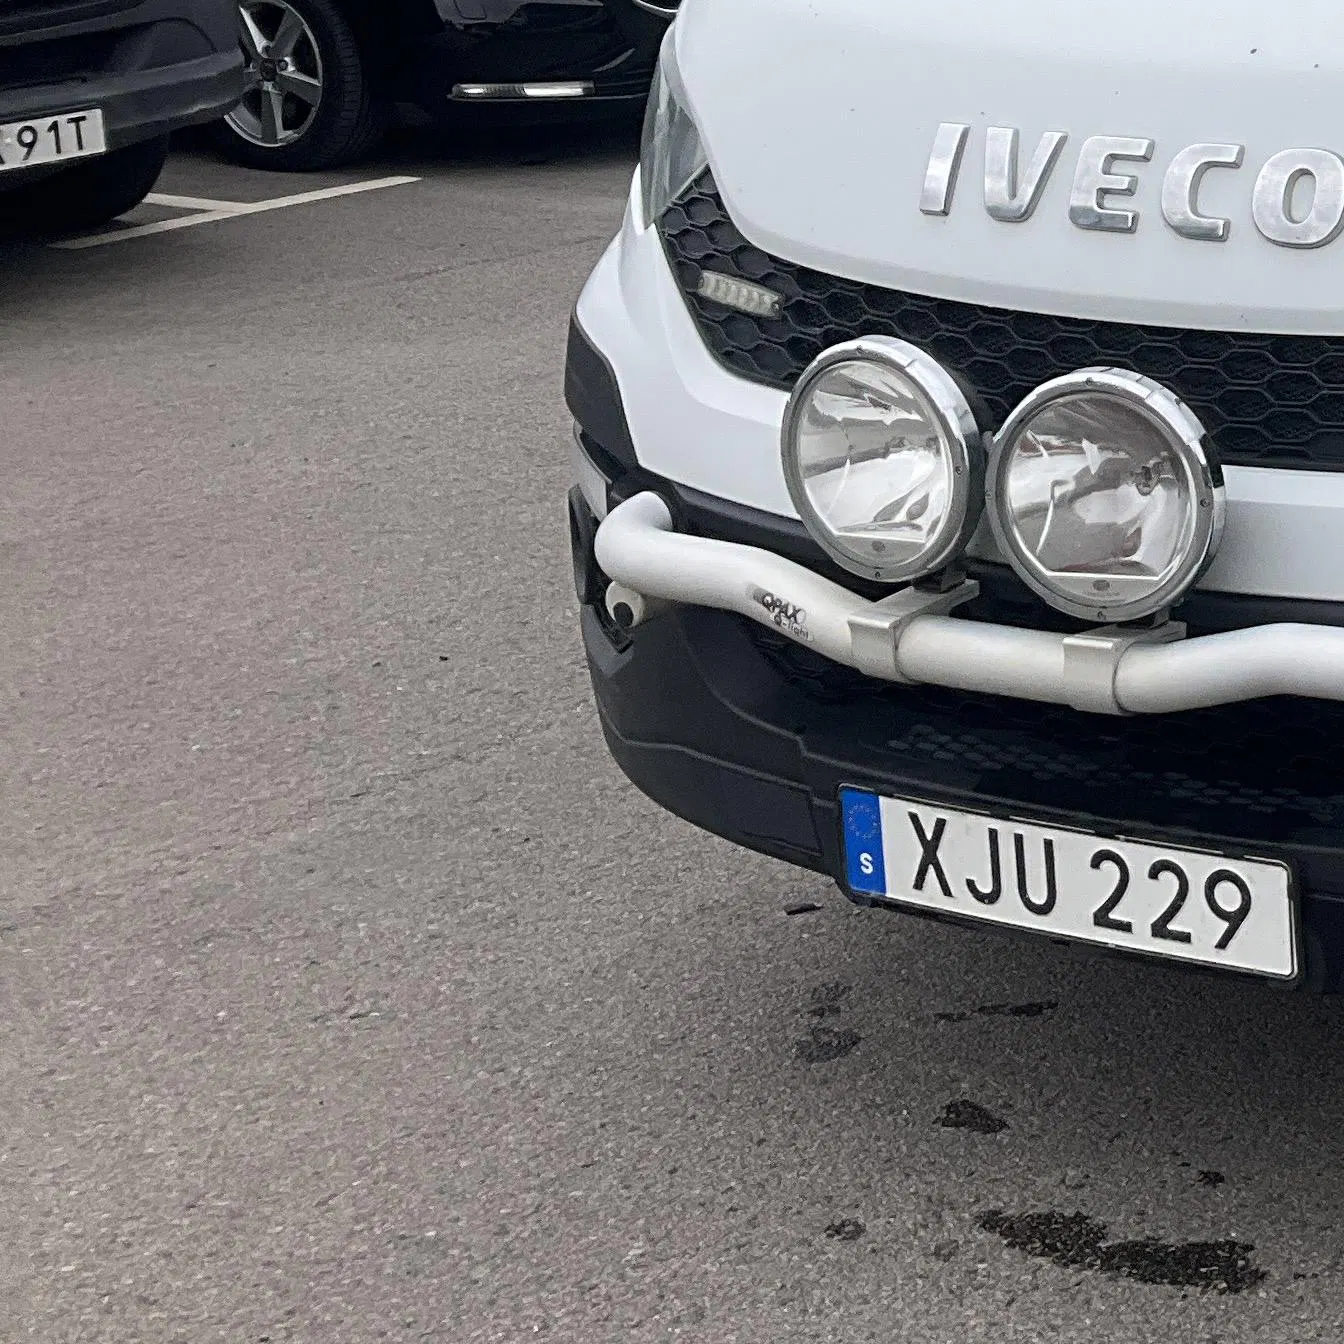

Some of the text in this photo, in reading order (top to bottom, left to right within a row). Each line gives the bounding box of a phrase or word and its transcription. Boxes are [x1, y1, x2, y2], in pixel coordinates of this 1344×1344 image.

[17, 116, 87, 162] 91T
[860, 852, 873, 874] S
[908, 811, 1252, 950] XJU 229
